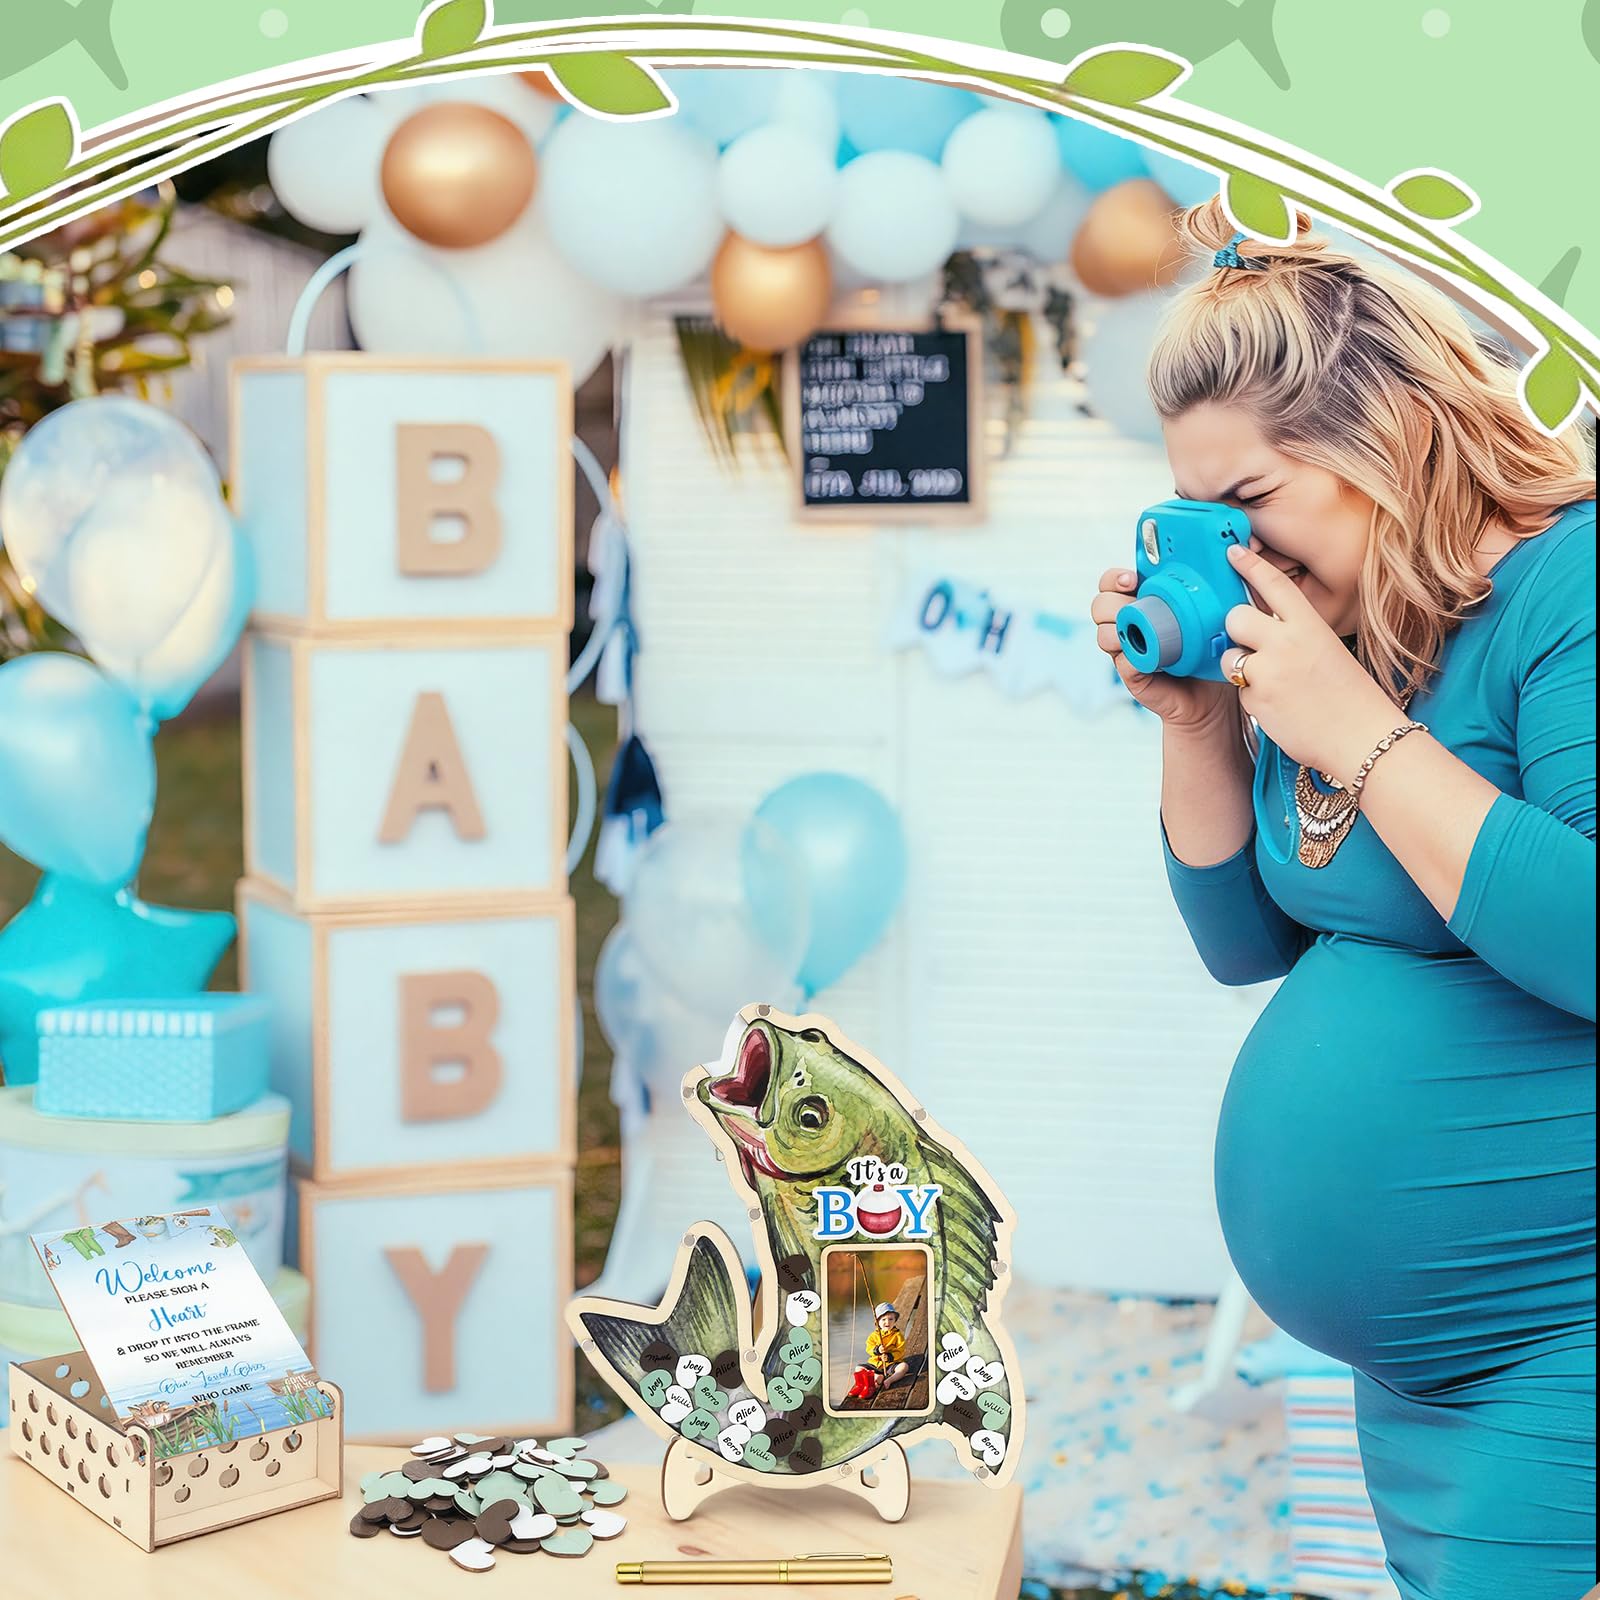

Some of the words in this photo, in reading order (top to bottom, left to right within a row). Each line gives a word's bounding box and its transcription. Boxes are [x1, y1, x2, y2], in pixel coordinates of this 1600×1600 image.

[851, 1160, 886, 1182] It's
[890, 1165, 904, 1180] a
[816, 1184, 939, 1236] BOY
[95, 1260, 217, 1296] Welcome
[780, 1263, 800, 1283] Borro
[124, 1290, 169, 1304] PLEASE
[170, 1283, 198, 1296] SIGN
[200, 1282, 210, 1291] A
[793, 1292, 814, 1307] Joey
[149, 1302, 207, 1332] Heart
[127, 1340, 159, 1354] DROP
[161, 1337, 171, 1346] IT
[173, 1331, 200, 1344] INTO
[201, 1326, 224, 1338] THE
[224, 1319, 260, 1332] FRAME
[143, 1353, 160, 1364] SO
[161, 1349, 181, 1360] WE
[180, 1344, 207, 1355] WILL
[209, 1334, 252, 1350] ALWAYS
[789, 1342, 811, 1360] Alice
[943, 1345, 964, 1362] Alice
[175, 1351, 235, 1370] REMEMBER
[683, 1360, 705, 1374] Joey
[715, 1361, 737, 1377] Alice
[792, 1371, 814, 1385] Joey
[974, 1366, 994, 1383] Joey
[192, 1391, 219, 1403] WHO
[222, 1383, 253, 1396] CAME
[648, 1377, 664, 1397] Joey
[701, 1386, 720, 1406] Borro
[774, 1385, 793, 1404] Borro
[950, 1377, 969, 1396] Borro
[671, 1393, 691, 1409] Willi
[984, 1400, 1005, 1415] Willi
[735, 1405, 757, 1422] Alice
[801, 1407, 817, 1426] Joey
[689, 1417, 710, 1431] Joey
[722, 1437, 741, 1456] Borro
[773, 1429, 795, 1447] Alice
[981, 1436, 1000, 1456] Borro
[749, 1446, 771, 1462] Willi
